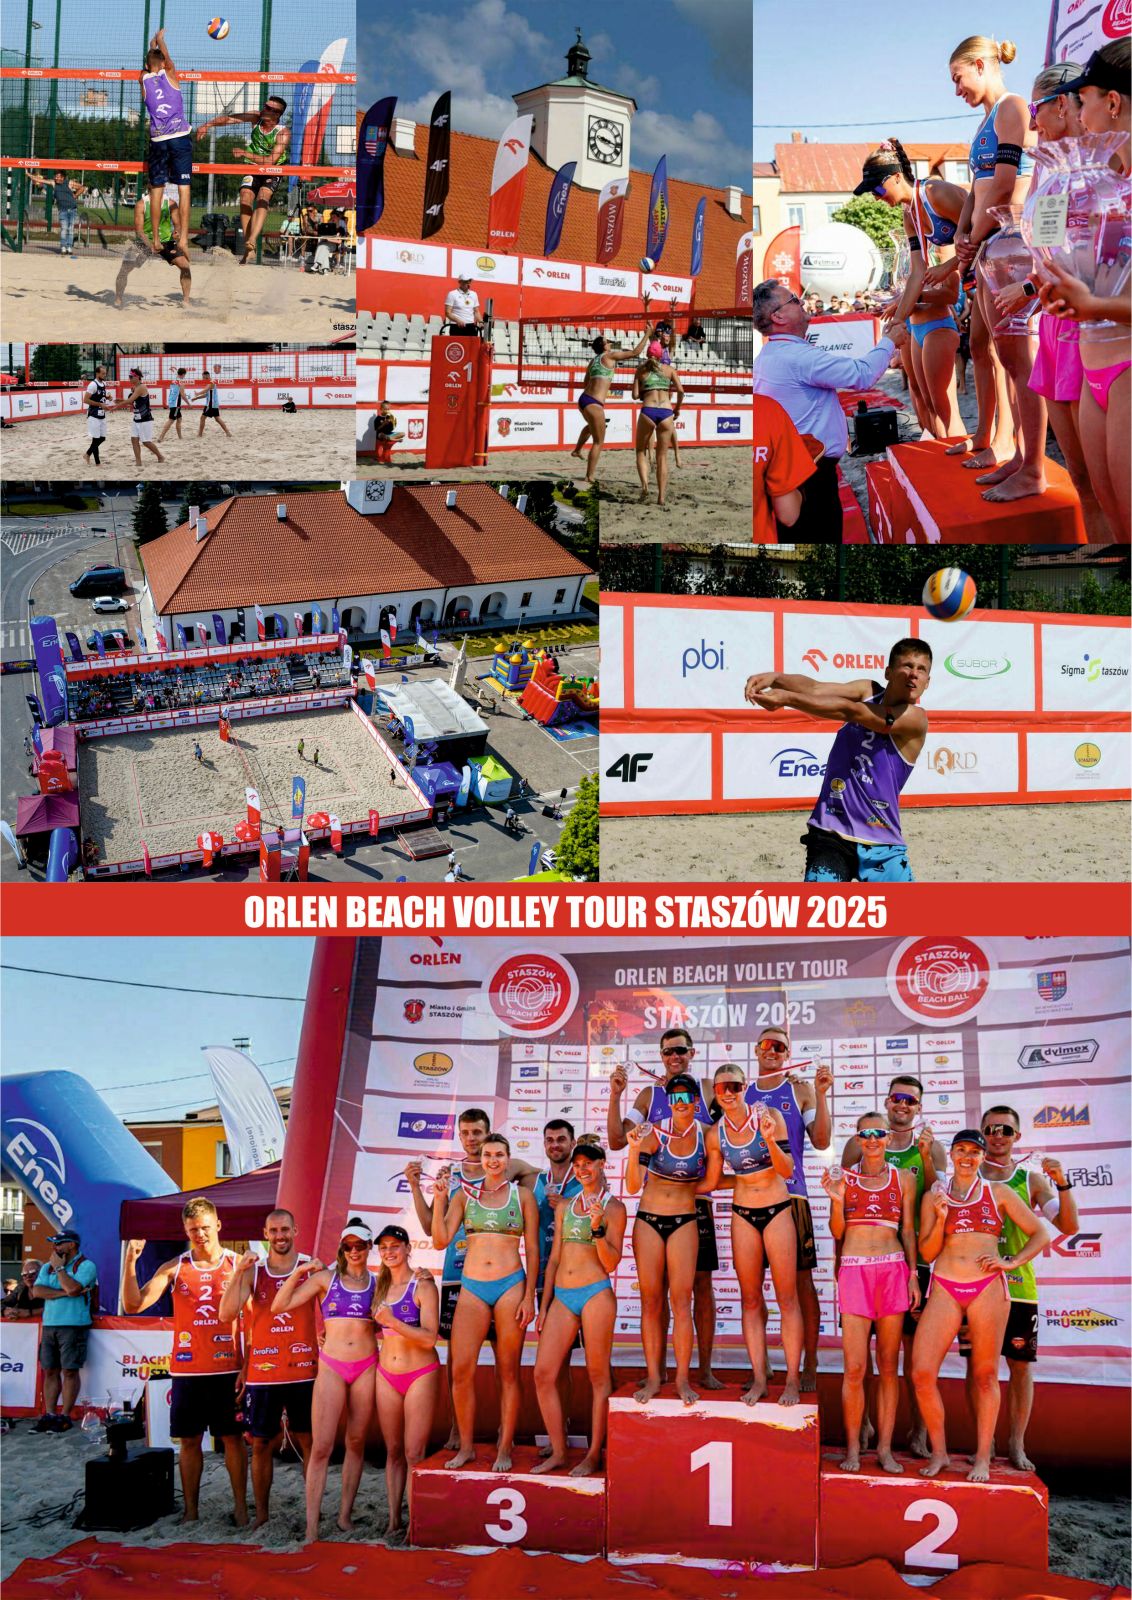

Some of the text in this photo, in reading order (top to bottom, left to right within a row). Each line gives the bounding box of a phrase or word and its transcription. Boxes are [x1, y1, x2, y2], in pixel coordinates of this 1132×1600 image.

[155, 89, 165, 100] 2
[433, 114, 449, 128] 4F
[430, 160, 448, 172] 4F
[556, 182, 569, 214] Enea
[605, 203, 617, 253] STASZÓW
[546, 270, 571, 280] ORLEN
[662, 285, 683, 294] ORLEN
[463, 361, 473, 383] 1
[520, 386, 552, 395] ORLEN
[683, 638, 725, 678] pbi
[832, 654, 885, 669] ORLEN
[956, 659, 997, 669] SUBOR
[1061, 664, 1085, 677] Sigma
[605, 752, 654, 783] 4F
[410, 953, 462, 966] ORLEN
[914, 949, 971, 963] STASZÓW
[507, 968, 556, 980] STASZÓW
[614, 959, 848, 985] ORLEN BEACH VOLLEY TOUR
[917, 993, 969, 1003] BEACH BALL
[456, 1004, 476, 1012] Gmina
[505, 1008, 532, 1017] BEACH
[644, 997, 816, 1029] STASZÓW 2025
[721, 1139, 726, 1147] 2
[8, 1131, 73, 1227] Enea
[1042, 1233, 1103, 1258] KG
[331, 1282, 338, 1290] 2
[199, 1285, 213, 1301] 2
[1045, 1309, 1092, 1318] BLACHY
[1046, 1316, 1118, 1329] PRUSZYŃSKI
[253, 1347, 279, 1355] EuroFish
[690, 1441, 733, 1526] 1
[484, 1488, 528, 1545] 3
[903, 1499, 959, 1569] 2
